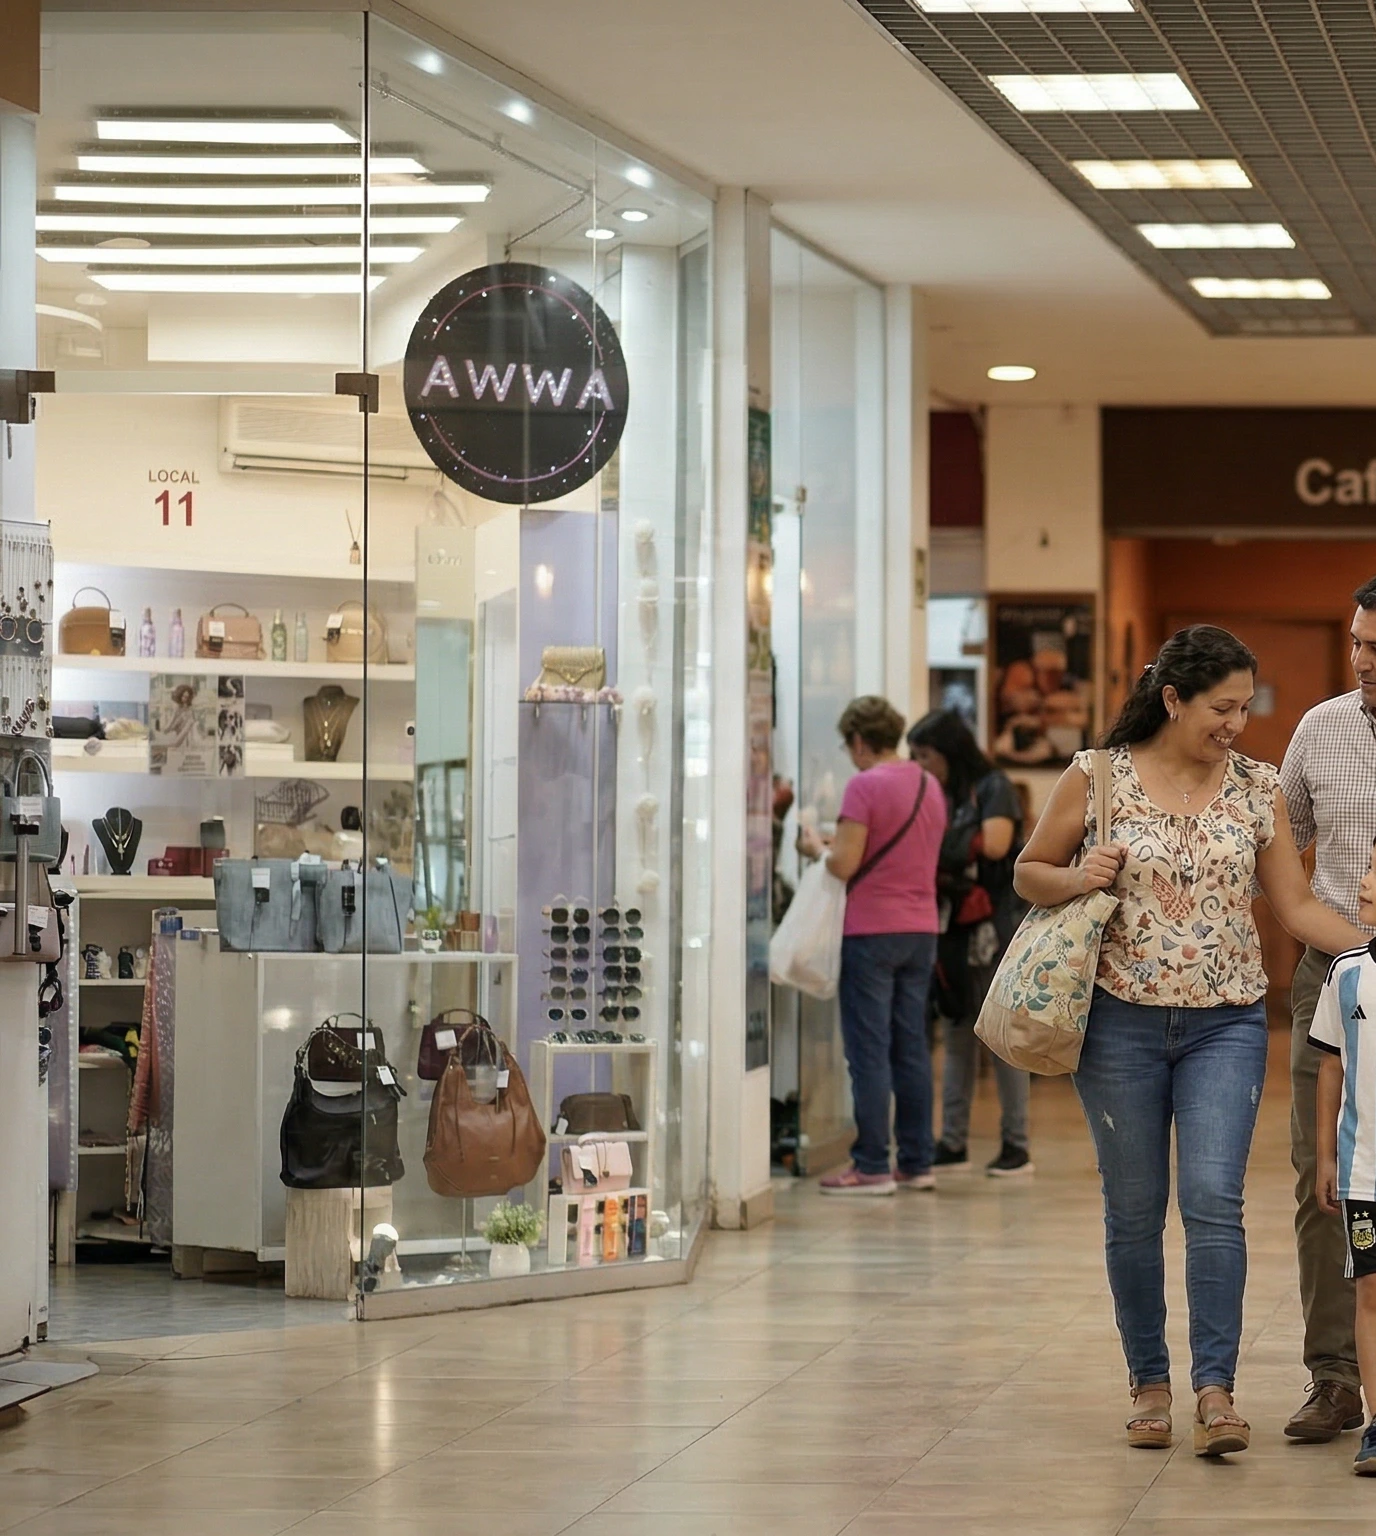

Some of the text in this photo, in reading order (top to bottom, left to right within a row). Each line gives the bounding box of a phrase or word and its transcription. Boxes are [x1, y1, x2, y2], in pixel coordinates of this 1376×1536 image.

[420, 354, 616, 411] AWWA
[148, 469, 200, 484] LOCAL
[154, 489, 193, 527] 11
